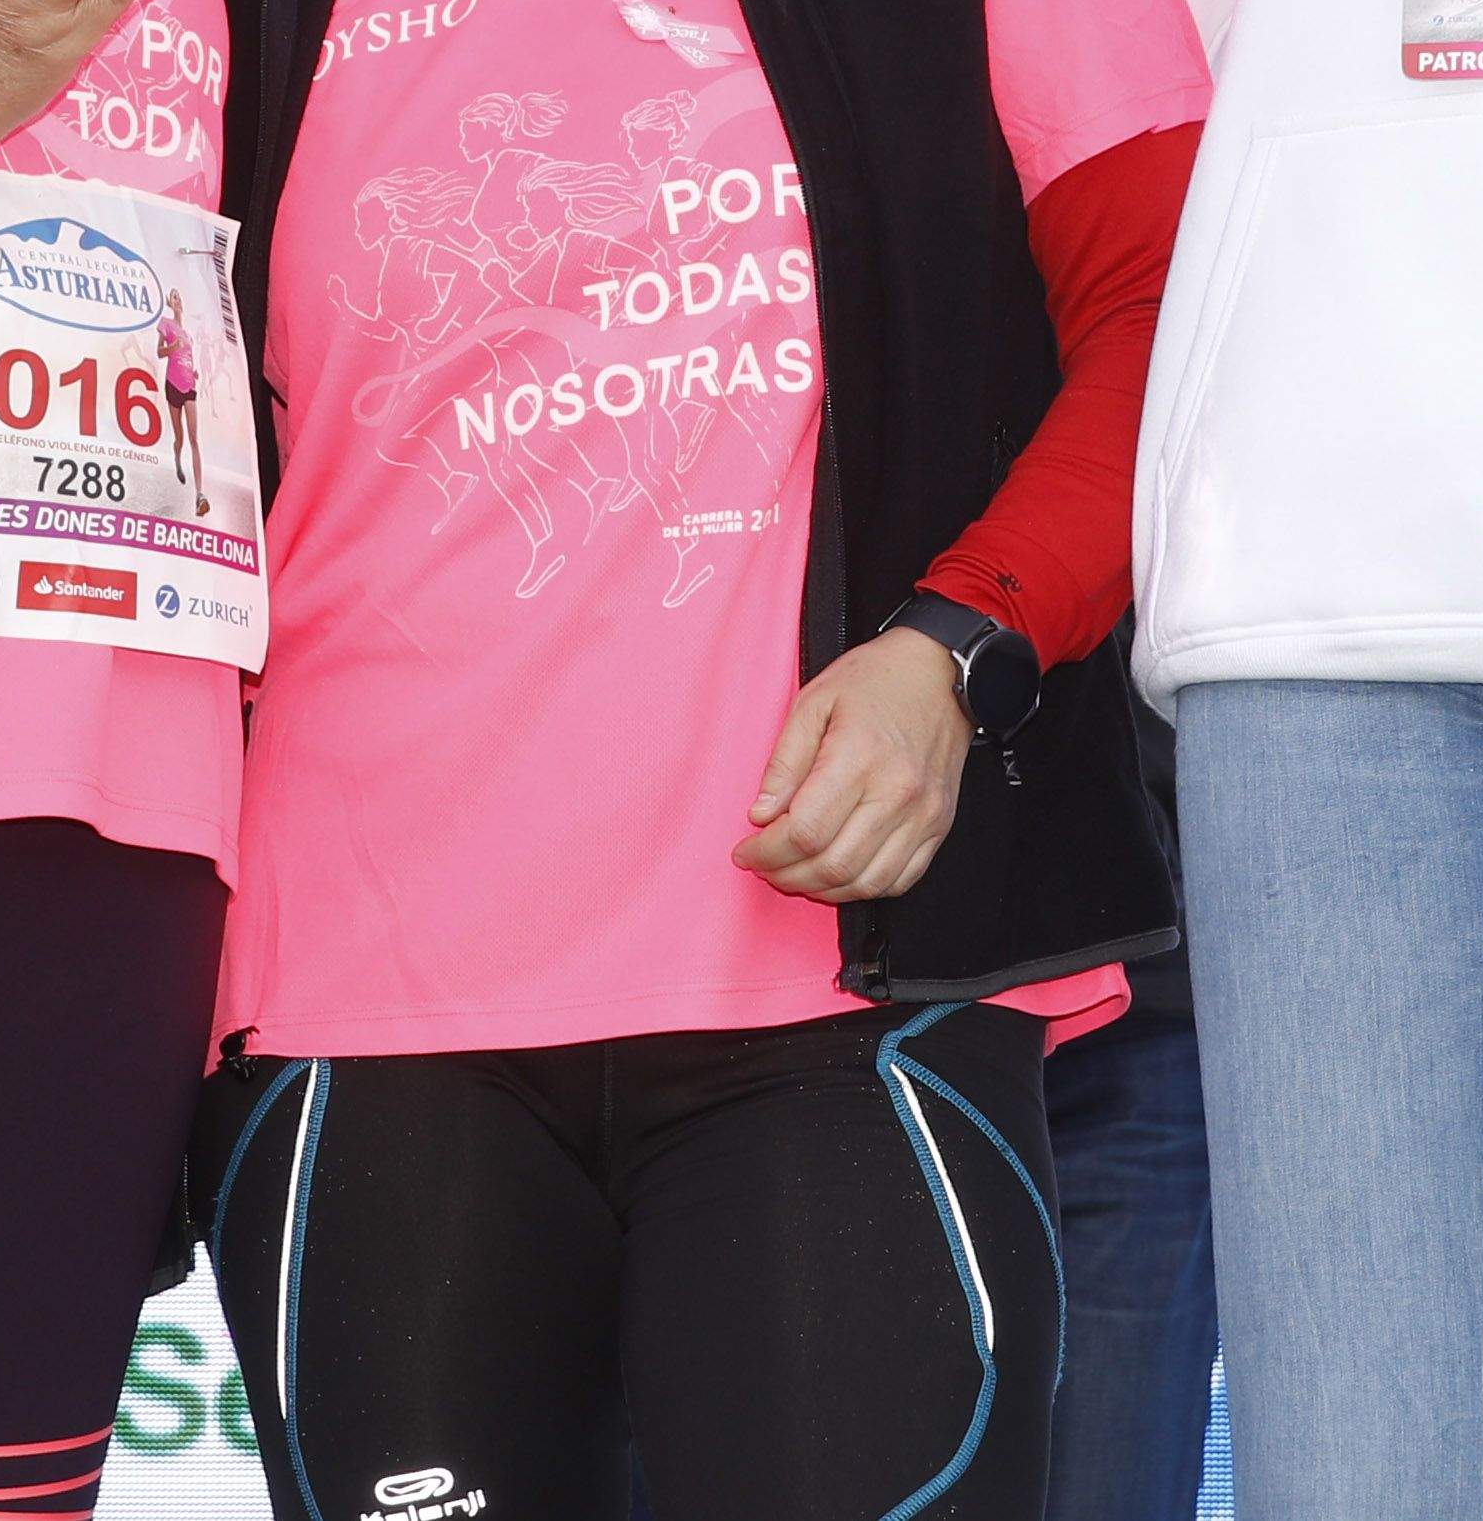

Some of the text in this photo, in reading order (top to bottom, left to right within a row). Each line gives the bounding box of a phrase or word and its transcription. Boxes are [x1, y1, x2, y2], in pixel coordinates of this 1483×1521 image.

[142, 19, 223, 106] POR
[66, 90, 208, 171] TODA
[661, 163, 807, 235] POR
[18, 249, 146, 279] CENTRAL LECHERA
[582, 248, 811, 332] TODAS
[454, 338, 814, 450] NOSOTRAS
[48, 440, 106, 456] VIOLENCIA
[108, 447, 121, 458] DE
[122, 447, 159, 465] GÉNERO
[33, 455, 126, 502] 7288
[663, 521, 743, 538] DE LA MUJER
[682, 510, 743, 525] CARRERA
[751, 502, 780, 532] 21
[35, 506, 116, 538] DONES
[121, 517, 150, 543] DE
[153, 523, 256, 568] BARCELONA
[55, 580, 125, 602] Santander
[189, 598, 249, 628] ZURICH
